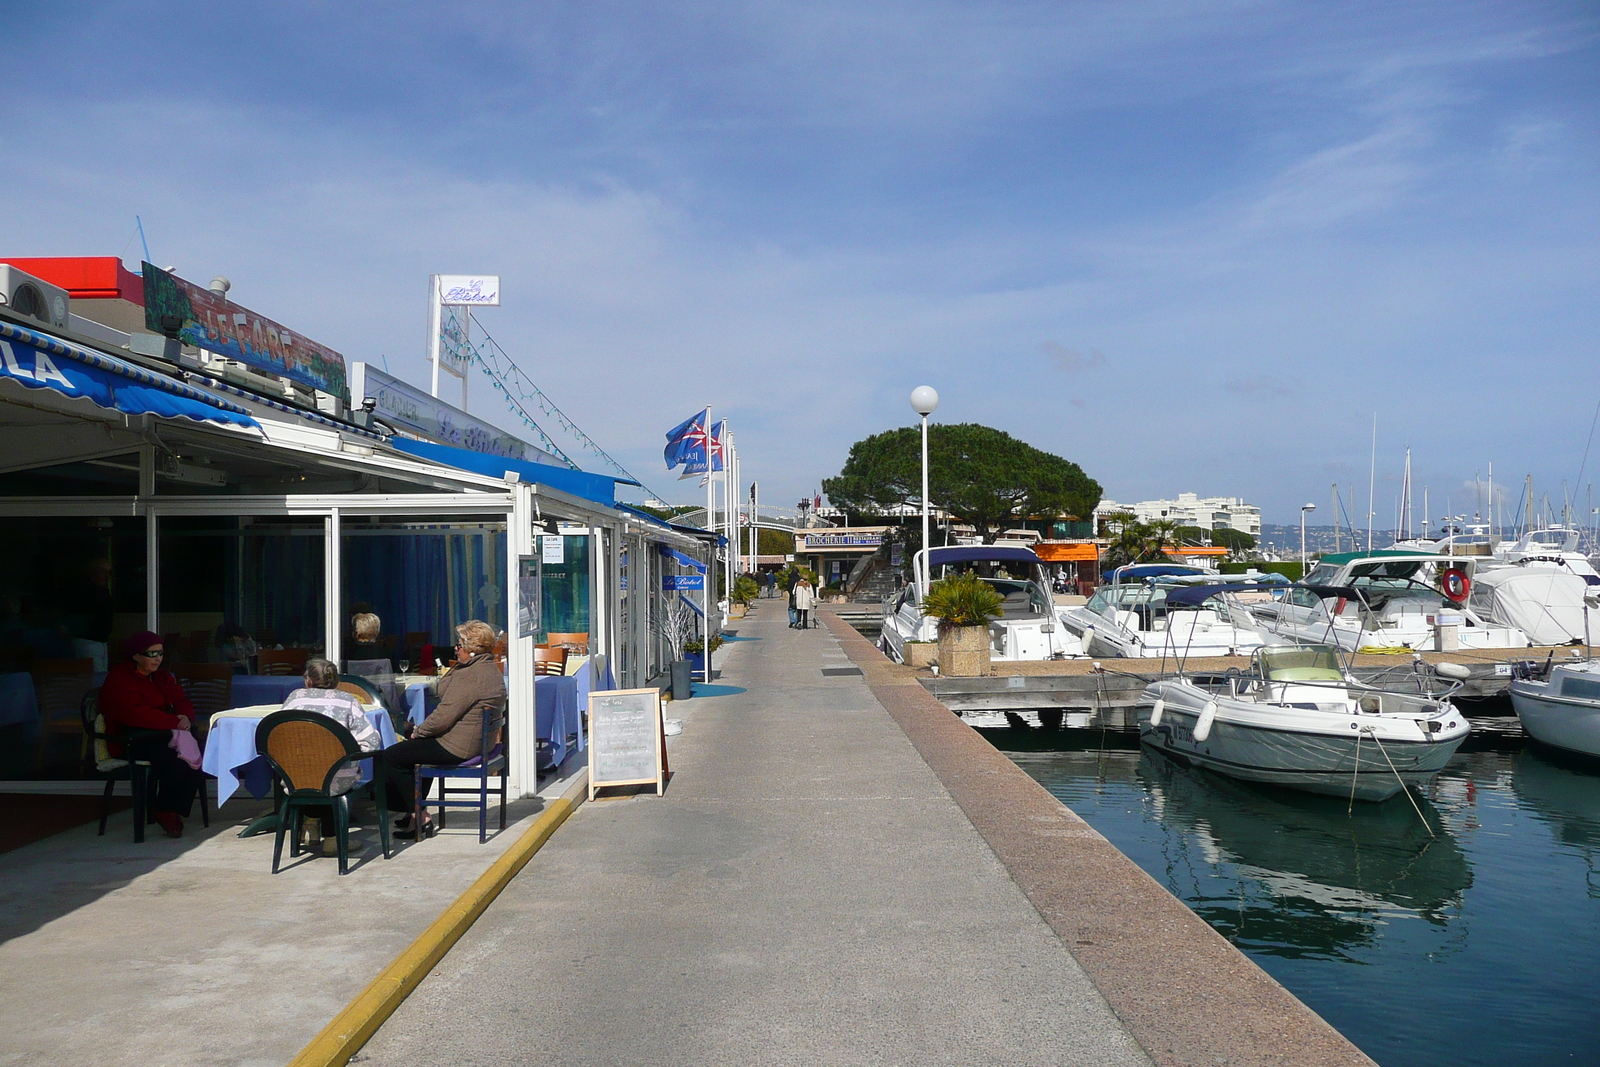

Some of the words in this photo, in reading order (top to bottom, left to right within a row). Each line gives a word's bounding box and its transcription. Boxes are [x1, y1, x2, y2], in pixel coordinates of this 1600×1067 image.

[206, 310, 230, 345] LE
[0, 339, 76, 389] LA
[807, 537, 846, 545] BROCHERIE
